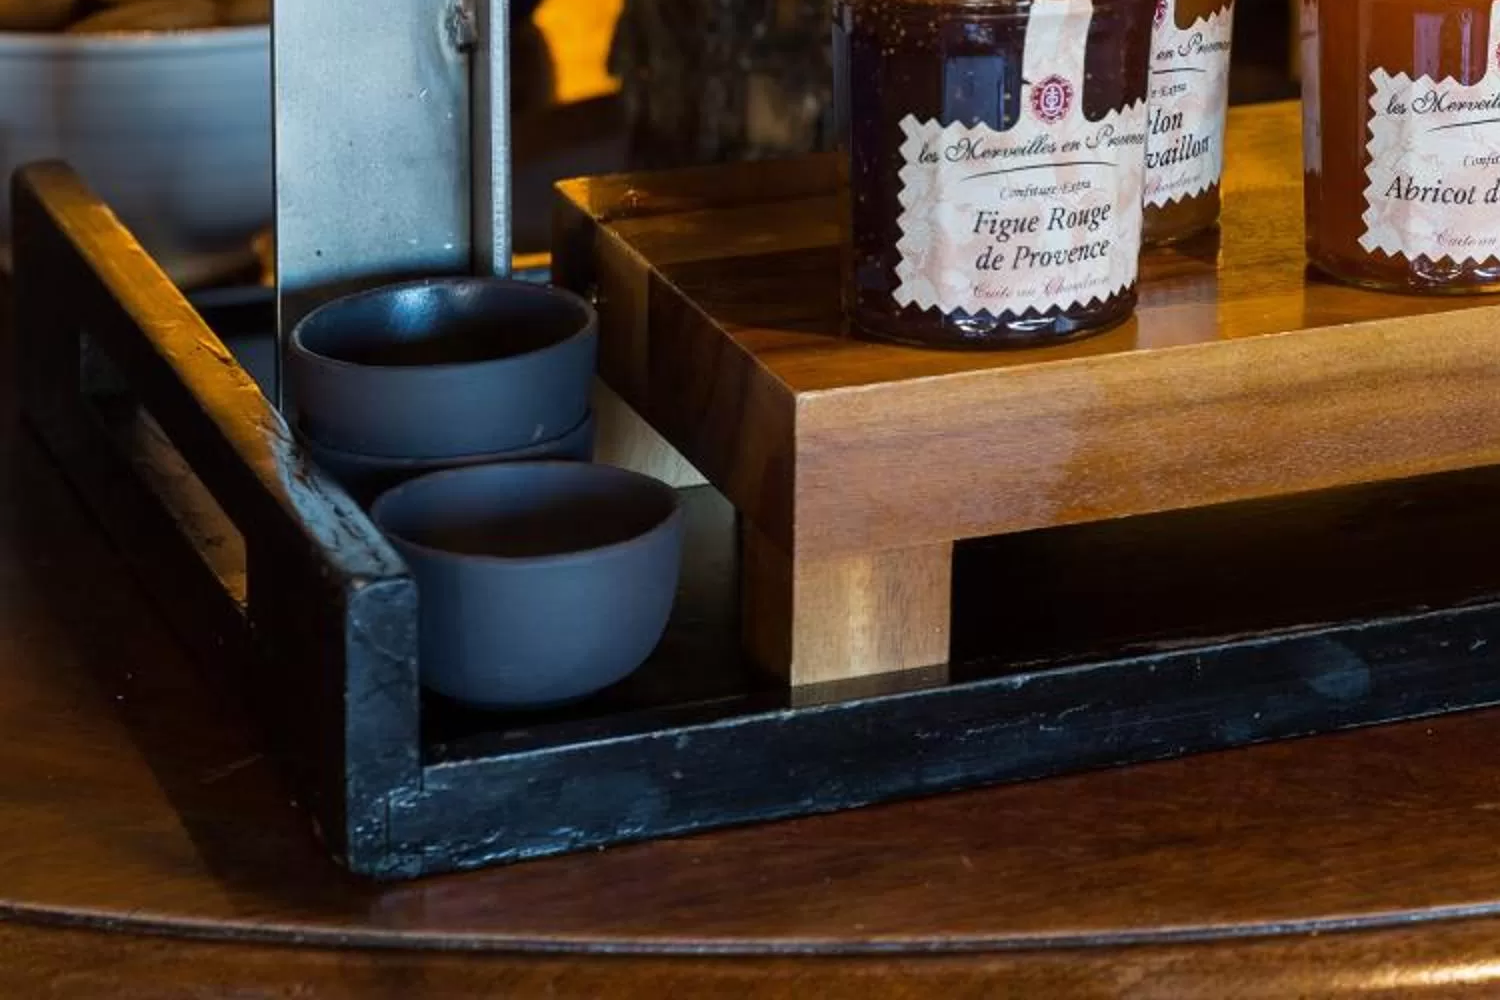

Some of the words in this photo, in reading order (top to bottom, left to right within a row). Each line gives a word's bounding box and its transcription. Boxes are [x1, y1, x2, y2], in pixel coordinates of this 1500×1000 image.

[1385, 94, 1407, 115] les
[1149, 107, 1183, 135] lon
[917, 143, 939, 164] les
[945, 134, 1057, 163] Merveilles
[1061, 140, 1081, 153] en
[1146, 132, 1212, 169] vaillon
[1385, 175, 1476, 205] Abricot
[973, 209, 1040, 243] Figue
[1046, 202, 1112, 232] Rouge
[975, 246, 1004, 271] de
[1012, 239, 1111, 270] Provence
